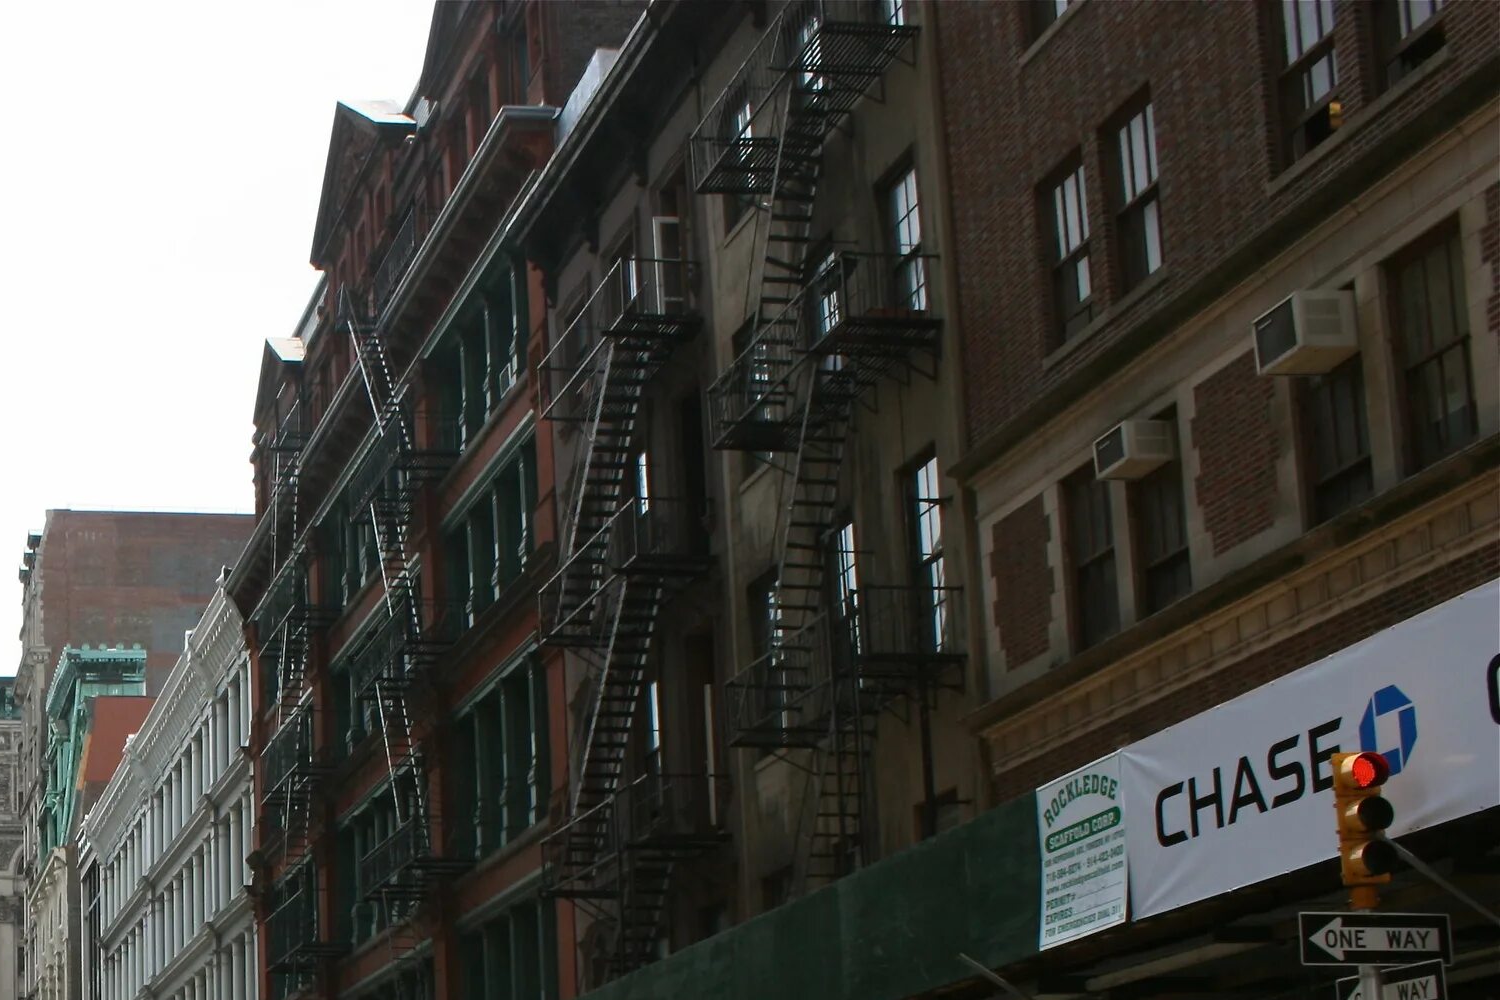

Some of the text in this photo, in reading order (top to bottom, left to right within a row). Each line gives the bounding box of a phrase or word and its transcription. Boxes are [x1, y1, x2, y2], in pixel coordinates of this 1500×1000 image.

[1044, 774, 1118, 828] ROCKLEDGE
[1155, 716, 1342, 847] CHASE
[1048, 822, 1090, 847] SCAFFOLD
[1325, 929, 1431, 949] ONE WAY
